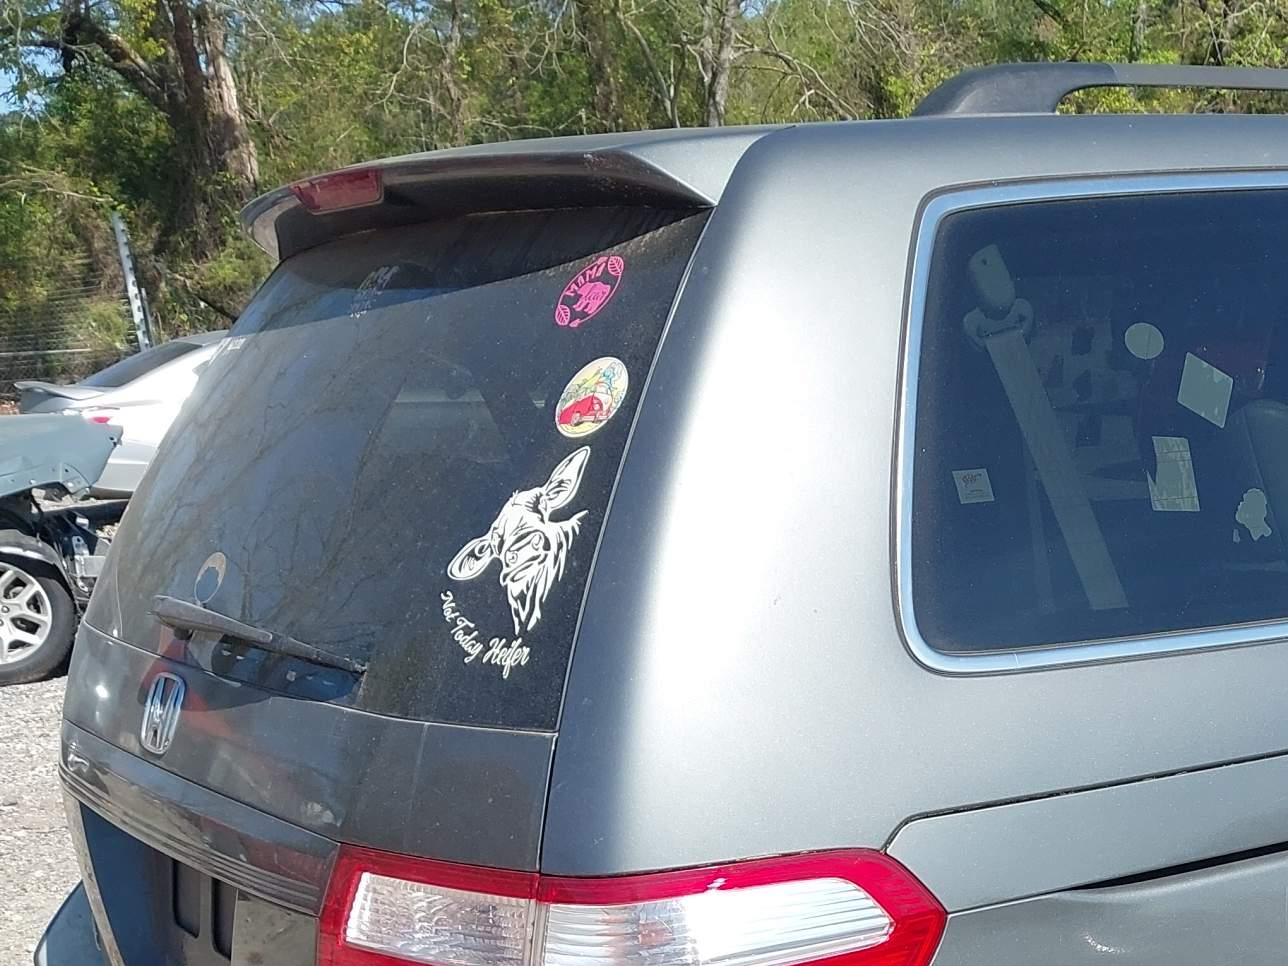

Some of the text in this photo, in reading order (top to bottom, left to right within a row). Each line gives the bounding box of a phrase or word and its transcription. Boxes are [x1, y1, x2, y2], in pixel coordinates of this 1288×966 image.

[565, 262, 606, 297] MAMA
[440, 590, 531, 679] Not Today Heifer
